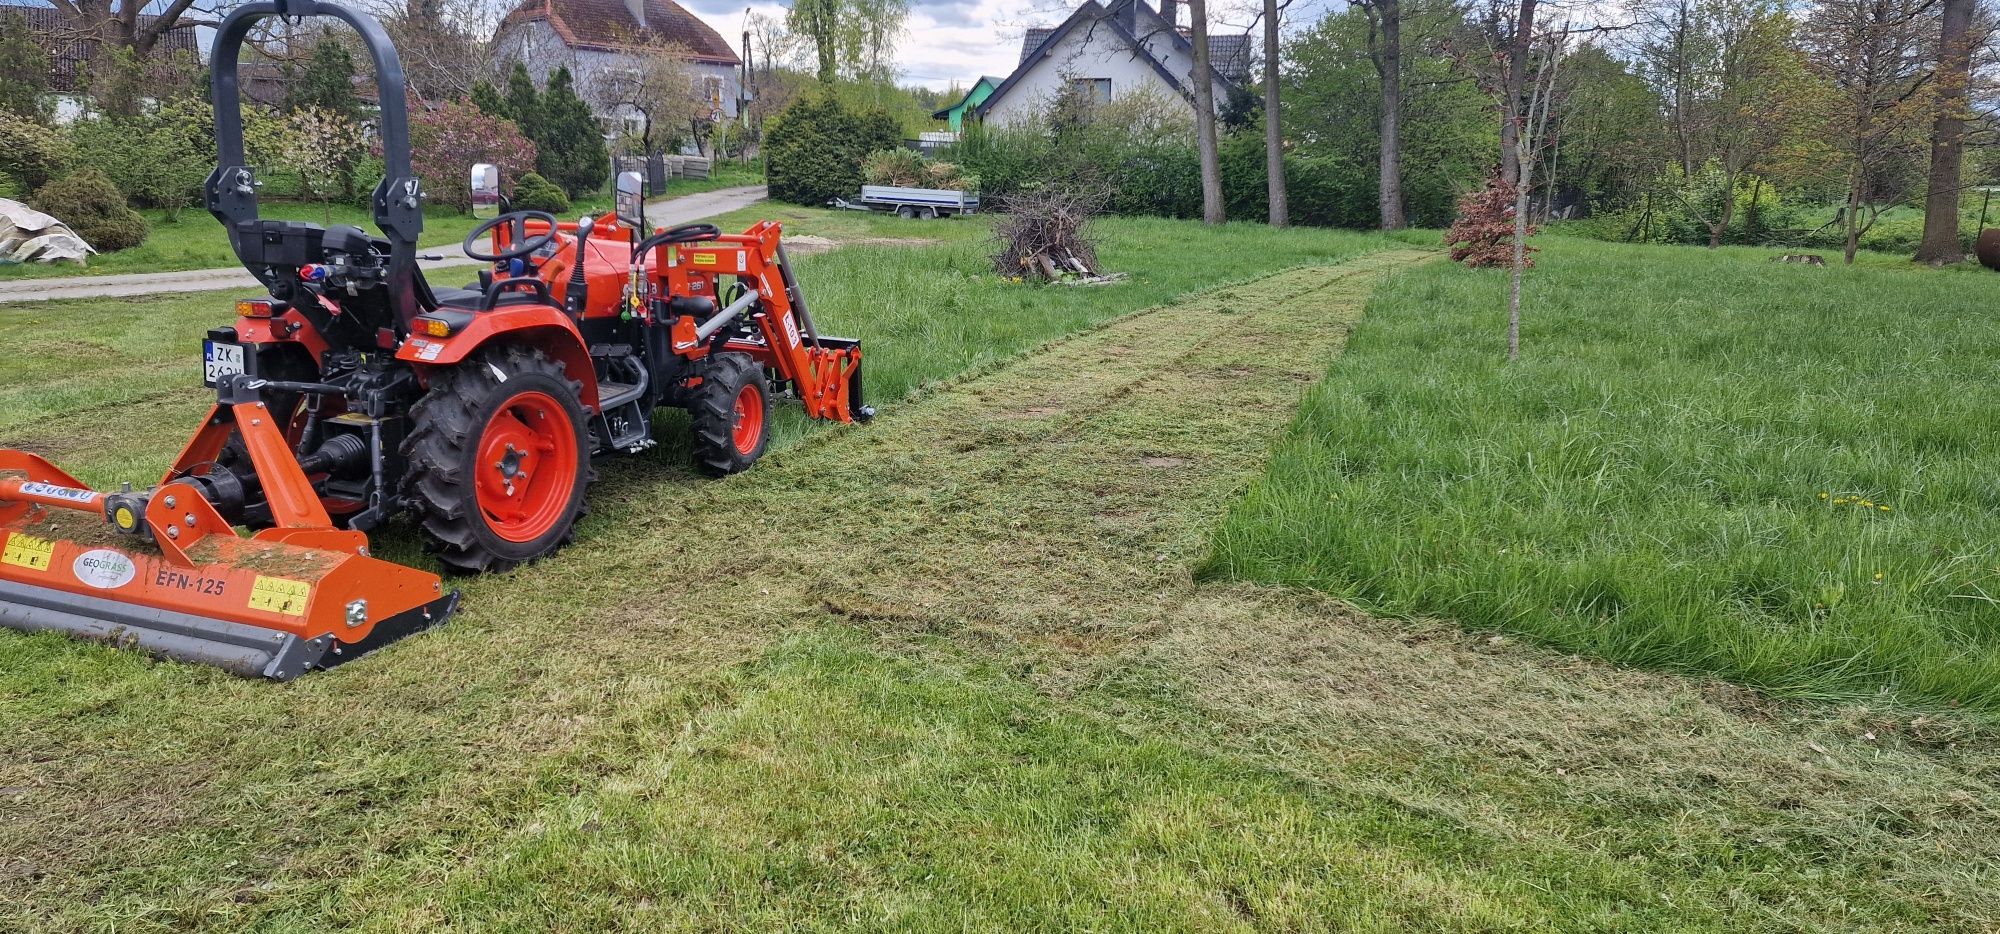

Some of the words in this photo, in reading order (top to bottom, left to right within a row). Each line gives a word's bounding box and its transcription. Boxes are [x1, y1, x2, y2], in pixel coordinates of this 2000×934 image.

[217, 347, 233, 363] ZK
[83, 557, 128, 573] GEOGRASS
[155, 571, 226, 596] EFN-125
